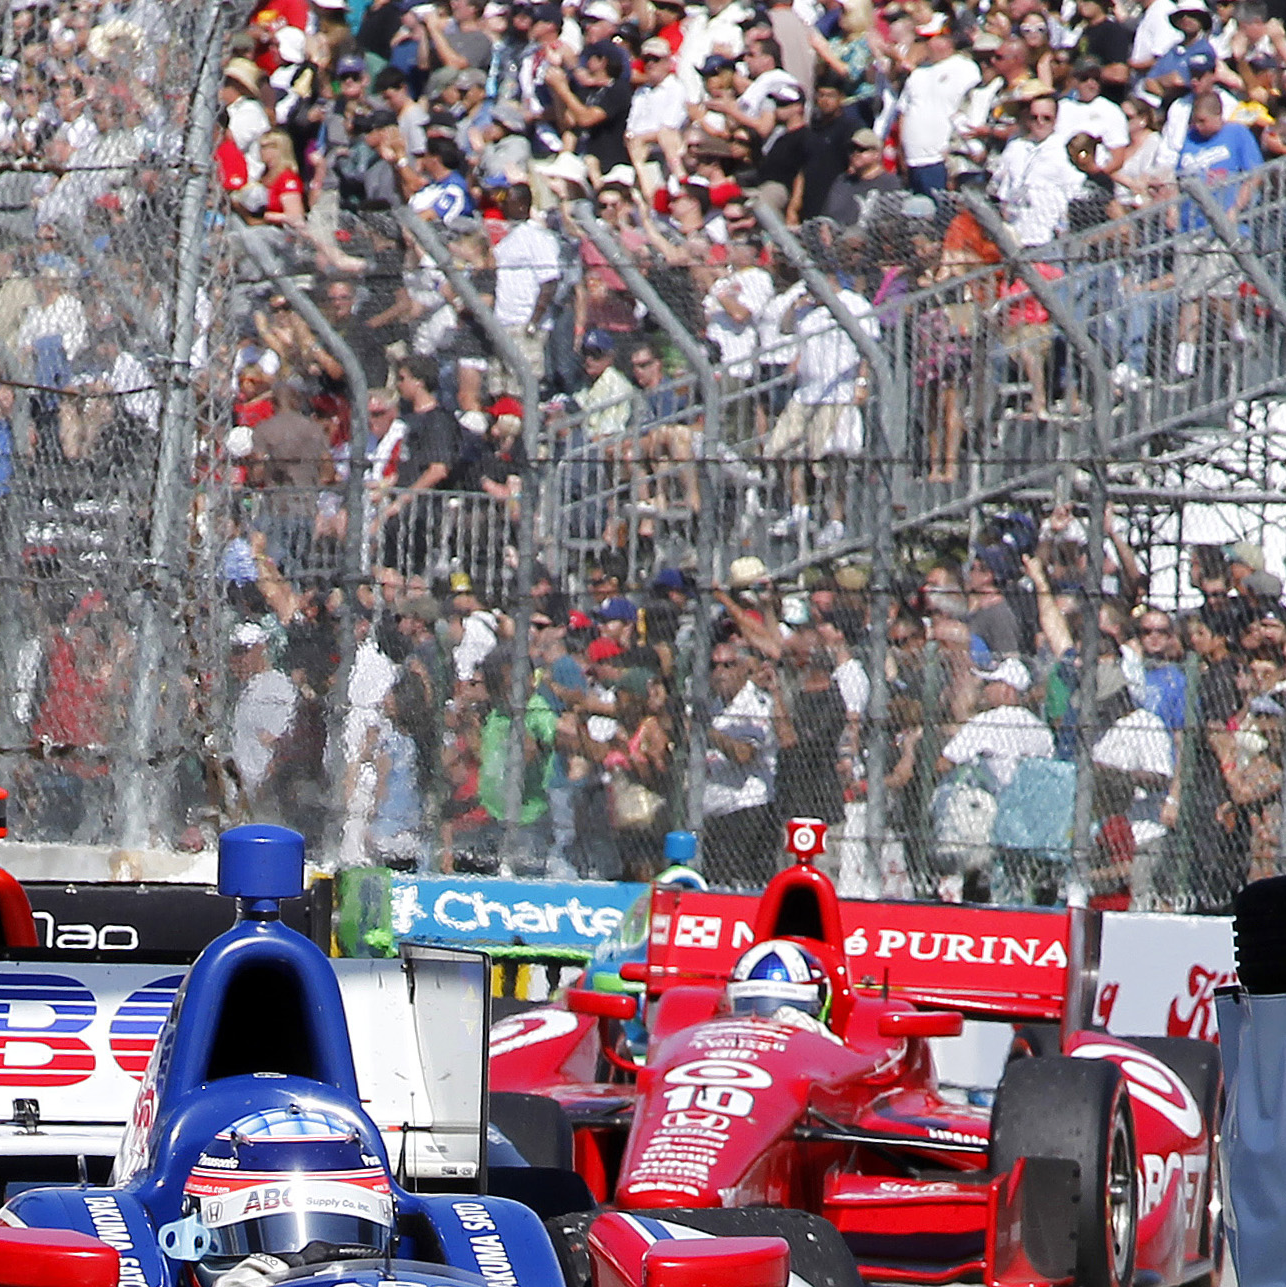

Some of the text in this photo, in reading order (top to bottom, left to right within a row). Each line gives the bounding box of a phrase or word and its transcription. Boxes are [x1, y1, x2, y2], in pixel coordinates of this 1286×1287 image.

[875, 929, 1068, 969] PURINA
[663, 1085, 755, 1118] 10
[305, 1196, 341, 1209] Supply
[342, 1199, 356, 1210] Co.
[357, 1202, 371, 1213] Inc.
[452, 1202, 497, 1232] SATO
[83, 1196, 134, 1251] TAKUMA
